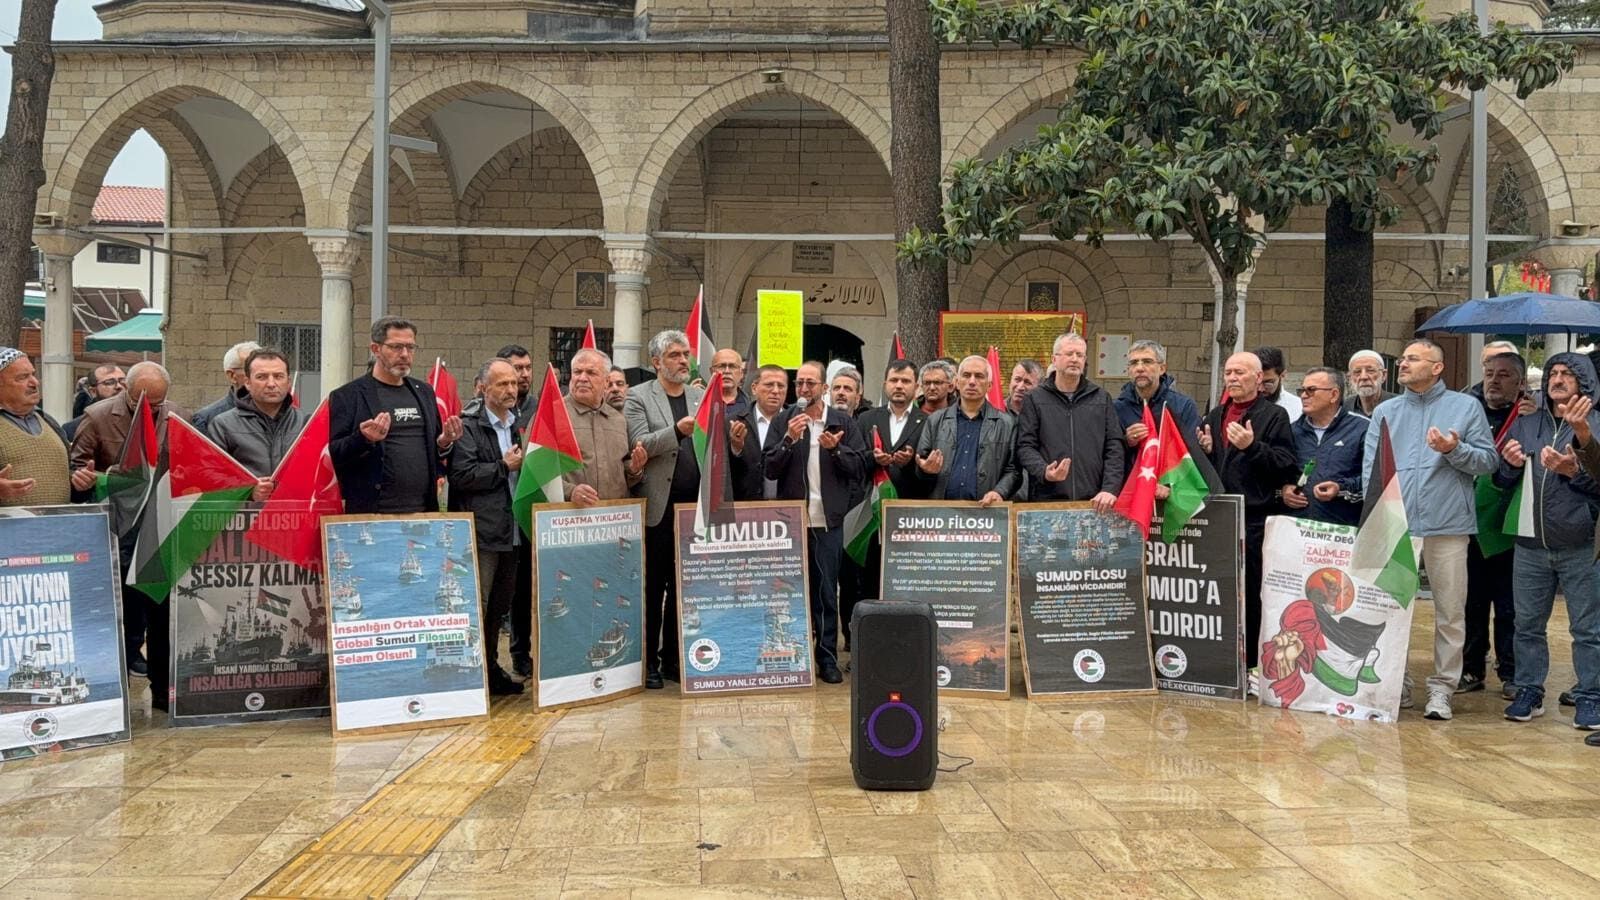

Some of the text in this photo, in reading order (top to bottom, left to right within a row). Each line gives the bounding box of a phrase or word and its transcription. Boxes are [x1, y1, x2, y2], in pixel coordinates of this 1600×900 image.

[192, 512, 246, 531] SUMUD
[552, 515, 592, 526] KUŞATMA
[898, 514, 994, 529] SUMUD FİLOSU
[541, 526, 585, 546] FİLİSTİN
[891, 530, 1001, 543] SALDIRI ALTINDA
[1334, 535, 1354, 545] DEĞ
[1146, 539, 1207, 573] SRAİL,
[1035, 567, 1128, 583] SUMUD FİLOSU
[0, 571, 70, 606] ÜNYANIN
[1036, 580, 1127, 593] İNSANLIĞIN VİCDANIDIR!
[1147, 575, 1221, 606] MUD'A
[334, 616, 469, 636] İnsanlığın Ortak Vicdanı
[1150, 609, 1223, 641] LDIRDI!
[335, 630, 464, 650] Global Sumud Filosuna
[336, 649, 413, 665] Selam Olsun!
[693, 680, 725, 690] SUMUD
[726, 678, 757, 688] YANLIZ
[758, 675, 799, 686] DEĞİLDİR
[1157, 679, 1217, 695] heExecutions
